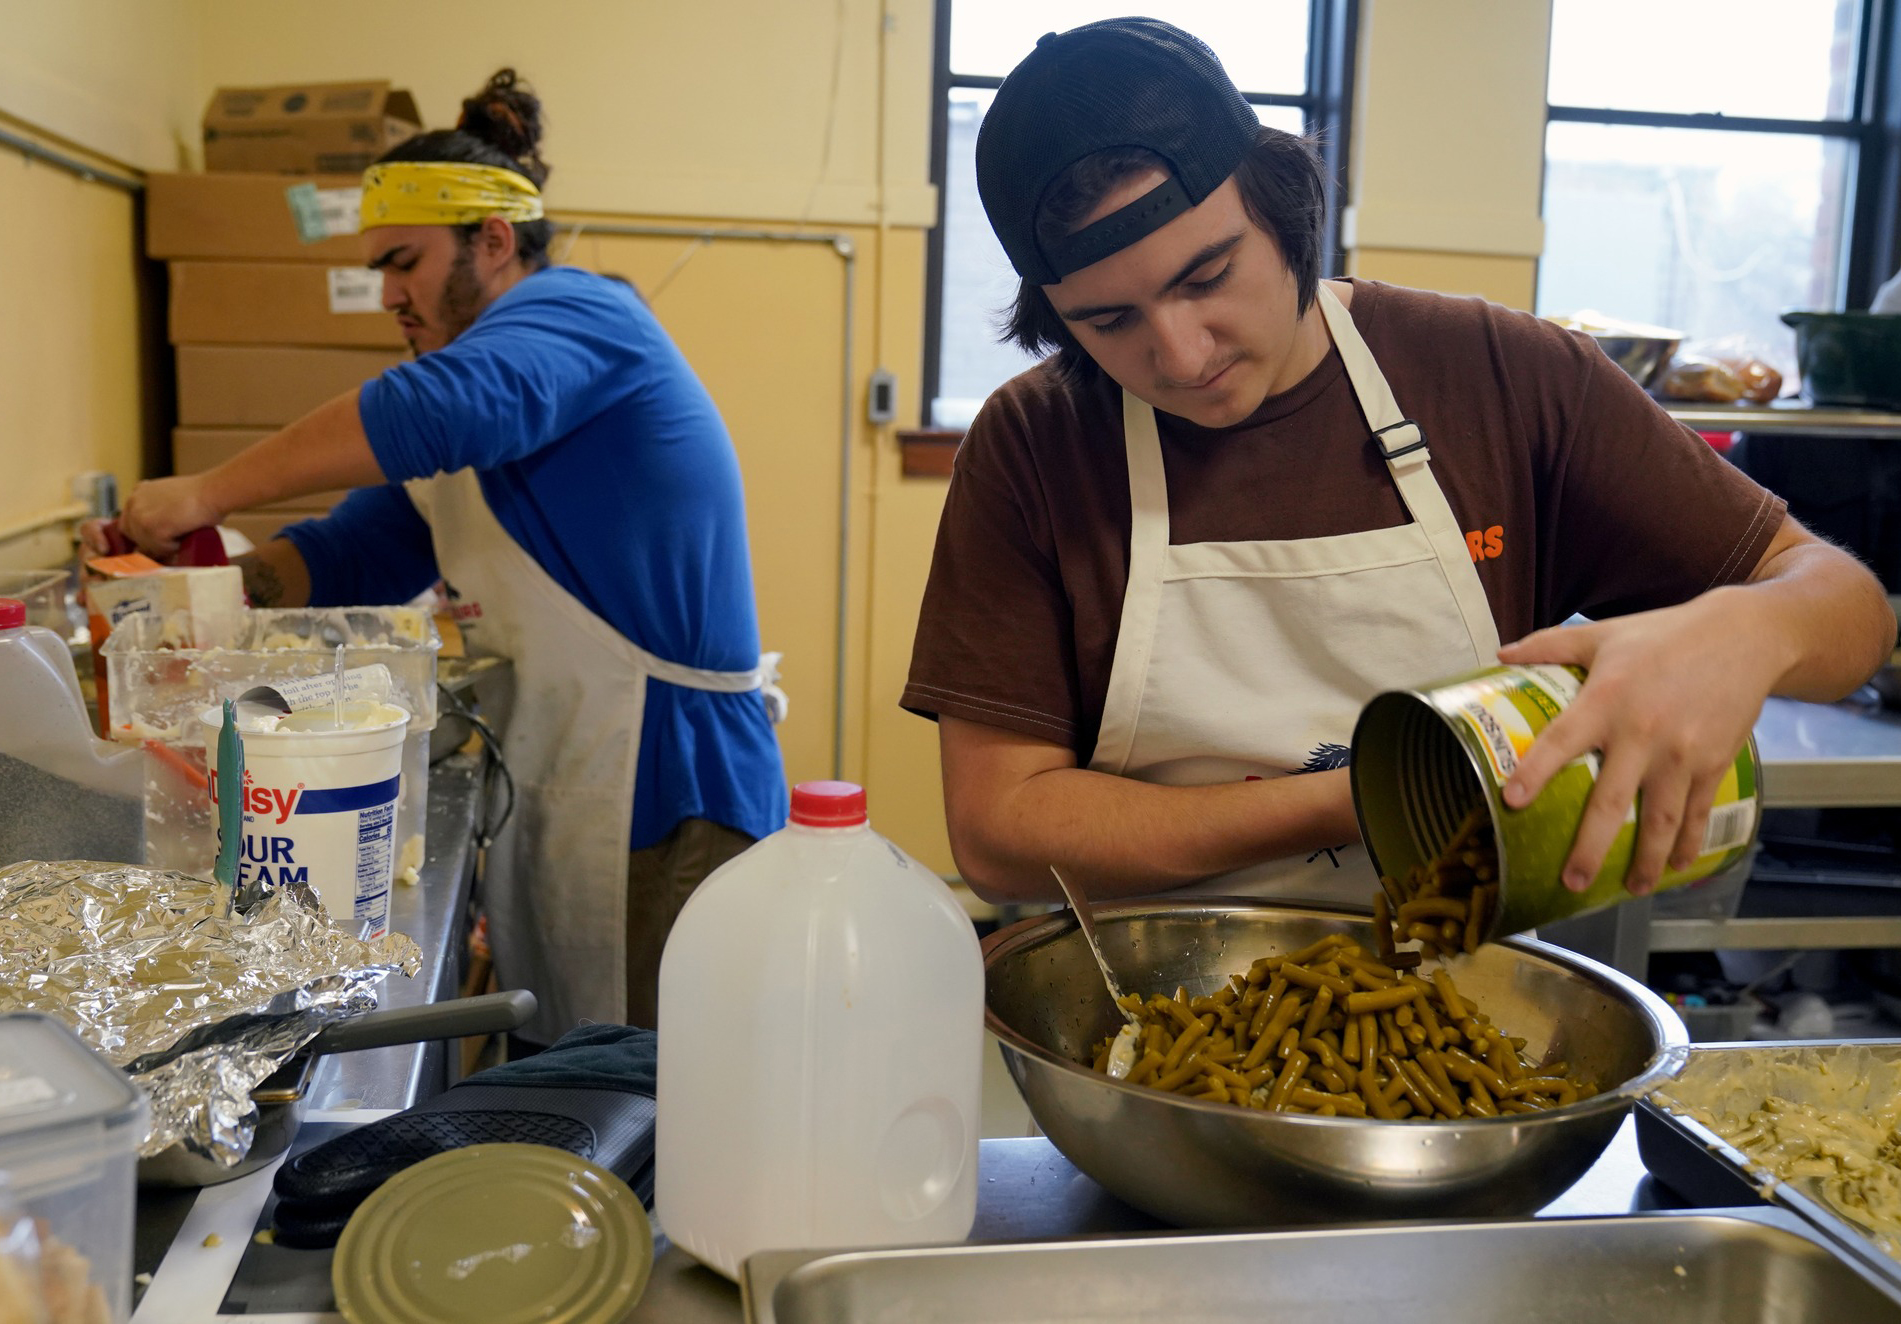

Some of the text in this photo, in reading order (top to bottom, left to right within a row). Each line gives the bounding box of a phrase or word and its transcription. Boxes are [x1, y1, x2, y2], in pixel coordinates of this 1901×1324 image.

[210, 768, 299, 825] isy
[217, 828, 295, 864] UR
[215, 855, 308, 887] EAM
